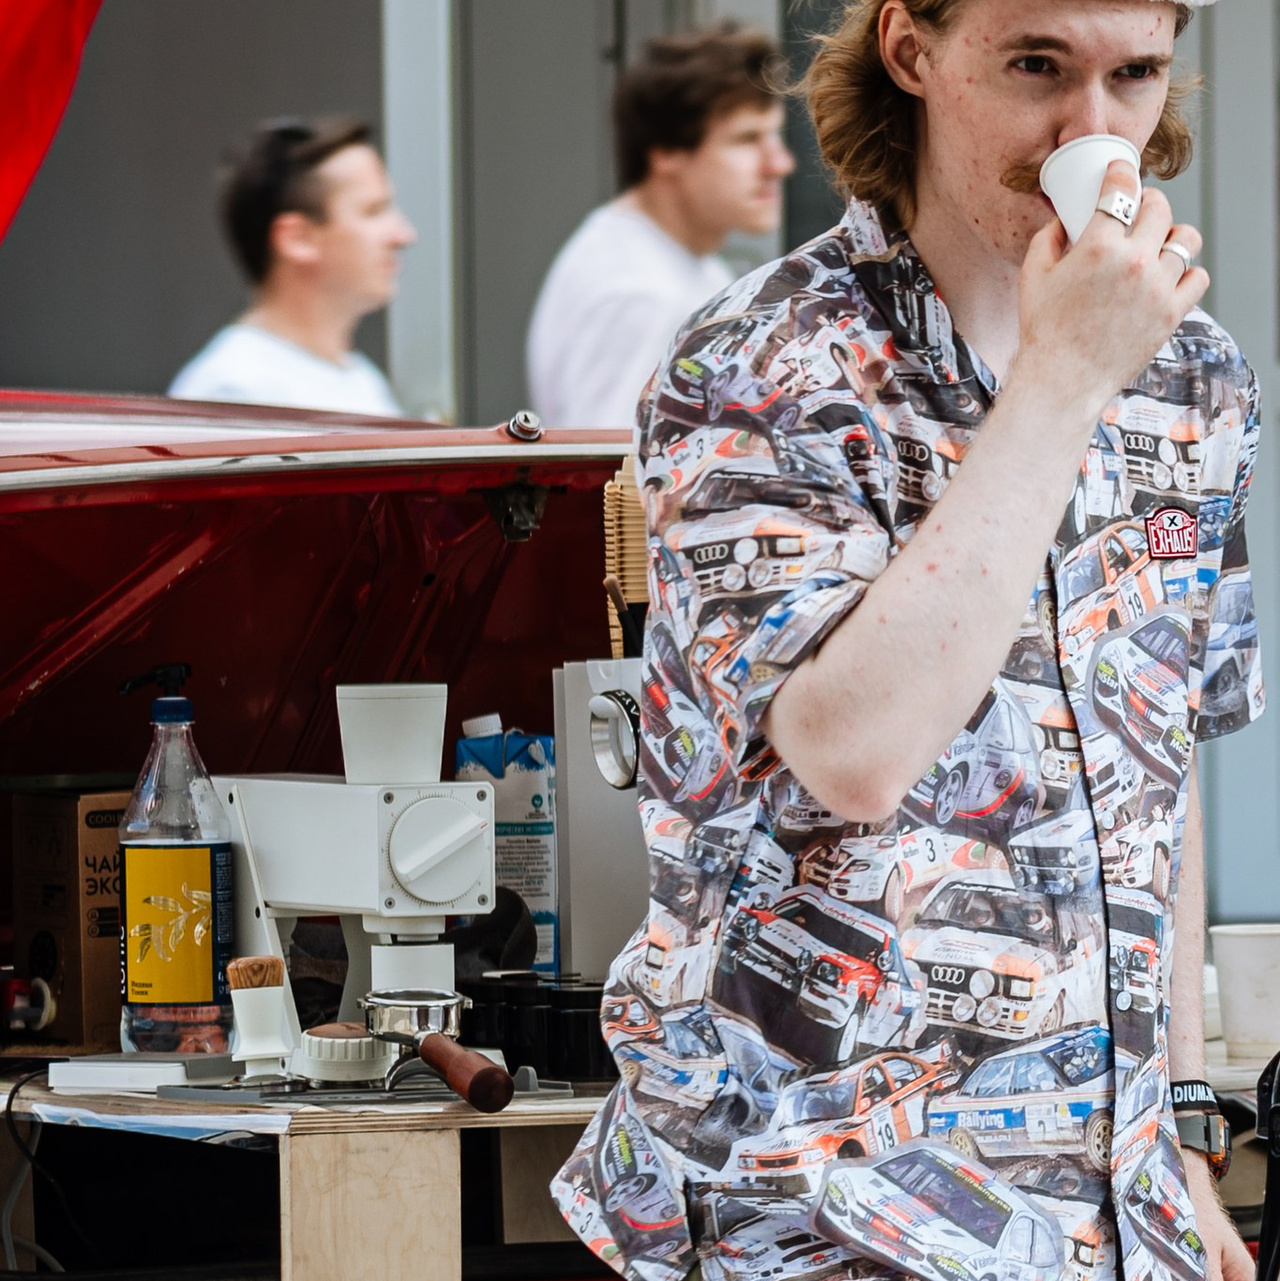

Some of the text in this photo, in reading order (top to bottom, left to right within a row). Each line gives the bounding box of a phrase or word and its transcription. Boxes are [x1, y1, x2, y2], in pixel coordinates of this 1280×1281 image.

[1166, 515, 1179, 528] X
[1150, 524, 1196, 554] EXHAUST
[1127, 592, 1144, 620] 19
[924, 838, 936, 863] 3
[878, 1122, 896, 1152] 19
